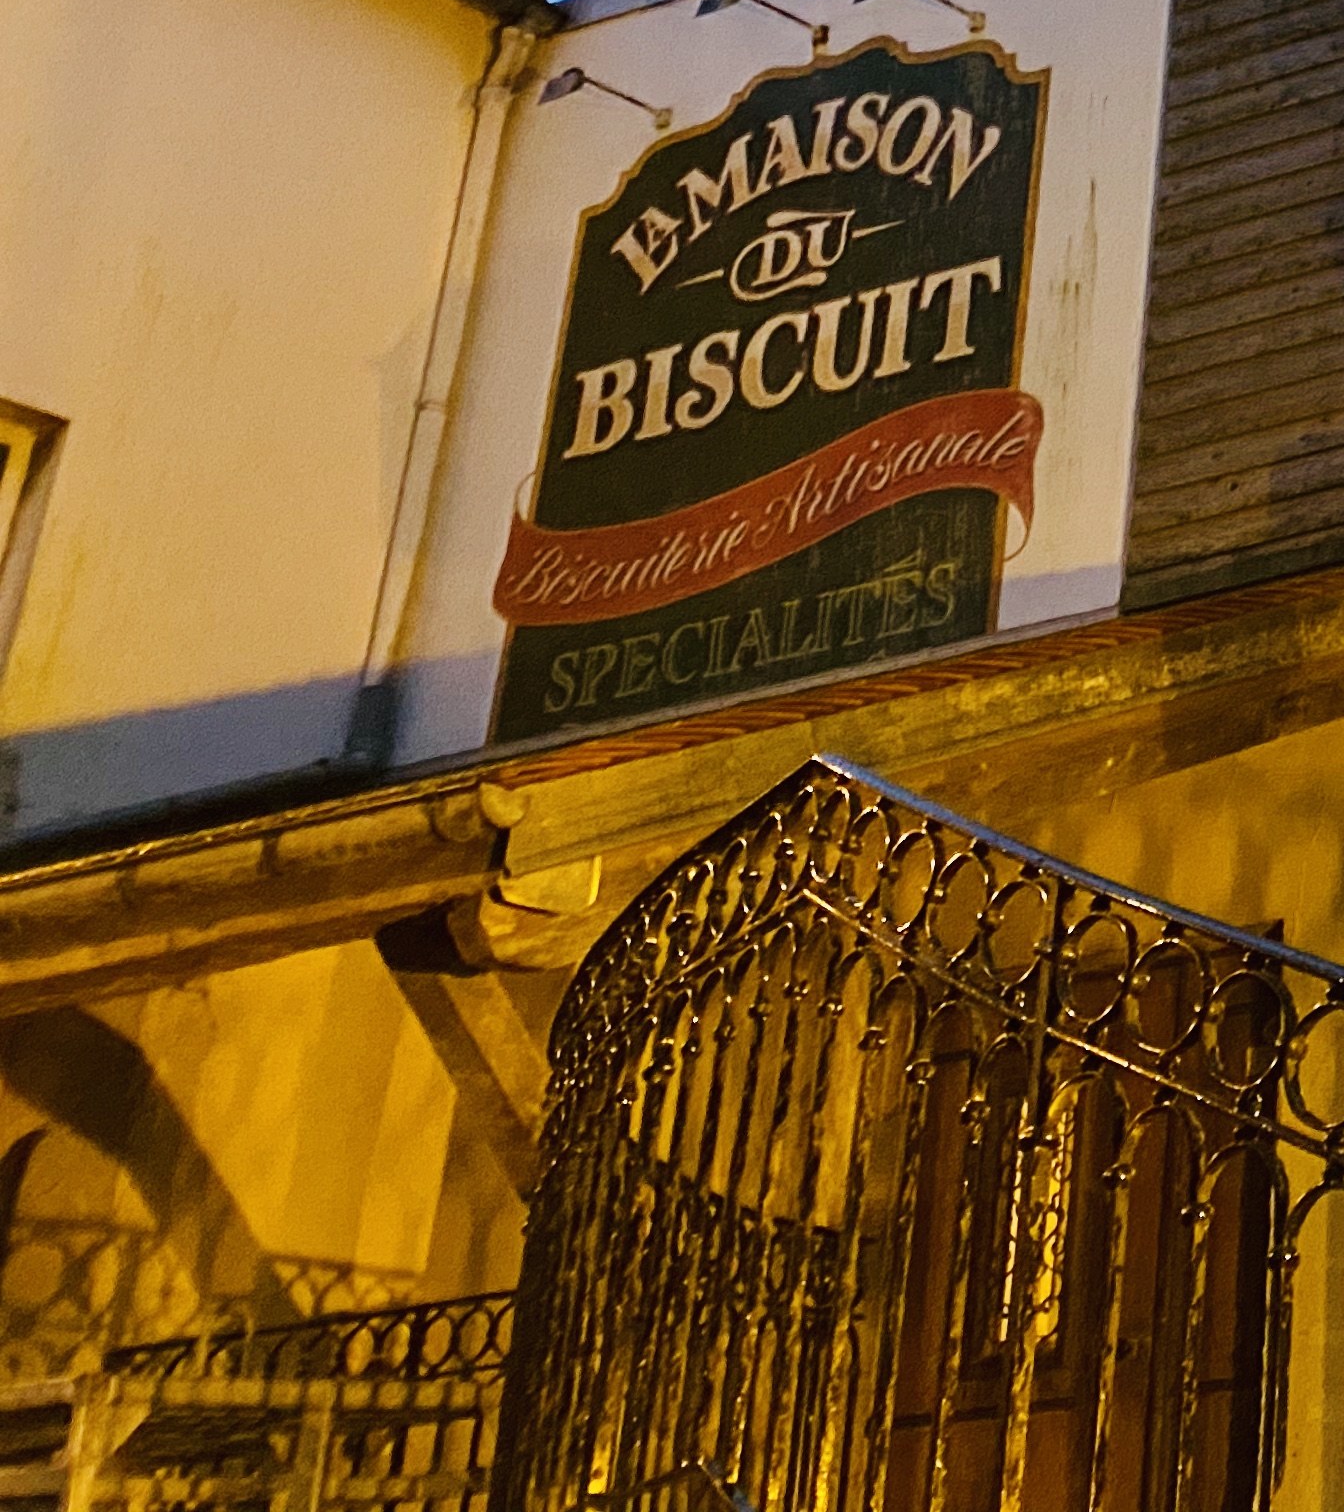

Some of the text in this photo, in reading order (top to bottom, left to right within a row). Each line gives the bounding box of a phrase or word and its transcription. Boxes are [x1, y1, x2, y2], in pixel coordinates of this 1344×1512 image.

[610, 91, 1001, 296] LA MAISON
[738, 209, 856, 296] DU
[562, 255, 1001, 460] BISCUIT
[500, 410, 1028, 606] Biscuiterie Artisanale
